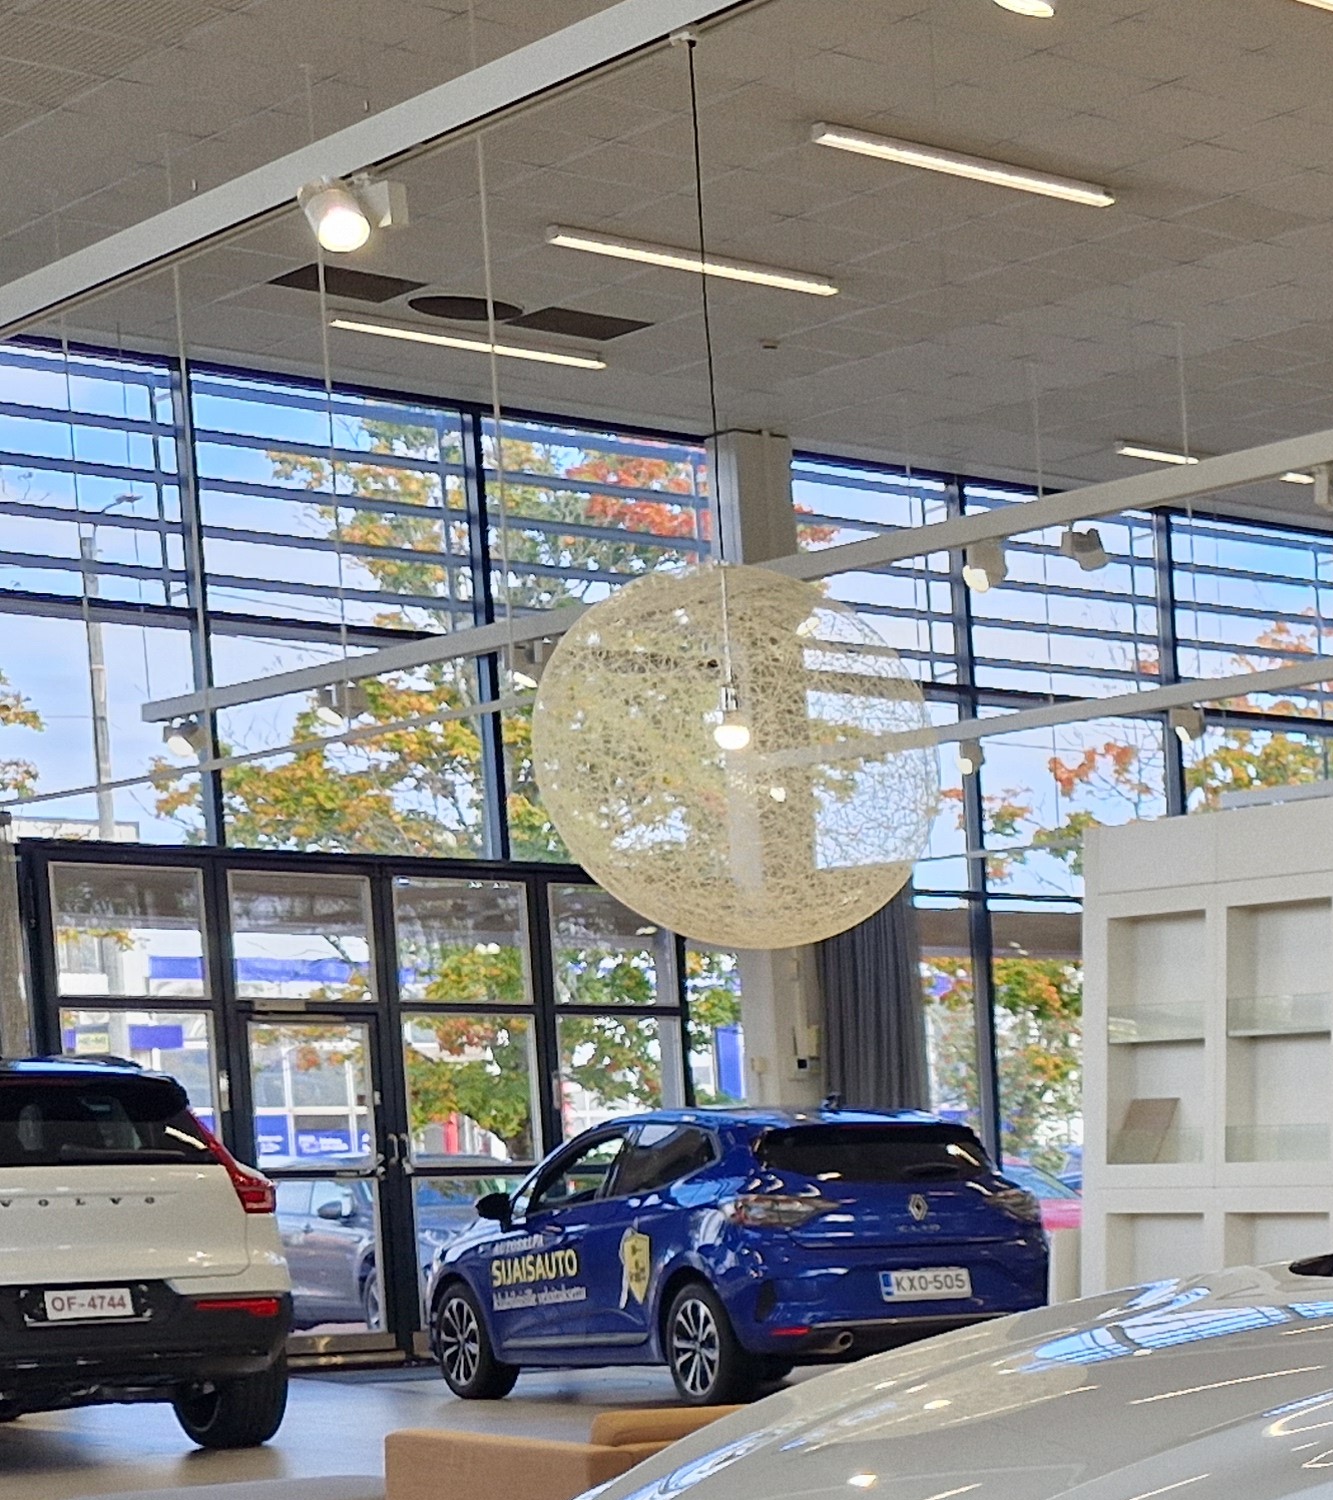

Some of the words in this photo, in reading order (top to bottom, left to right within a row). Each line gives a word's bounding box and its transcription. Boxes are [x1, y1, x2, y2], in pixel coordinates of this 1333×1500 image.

[0, 1196, 155, 1207] VOLVO
[492, 1248, 578, 1288] SIJAISAUTO
[895, 1274, 966, 1292] KXO-505
[51, 1296, 127, 1312] OF-4744
